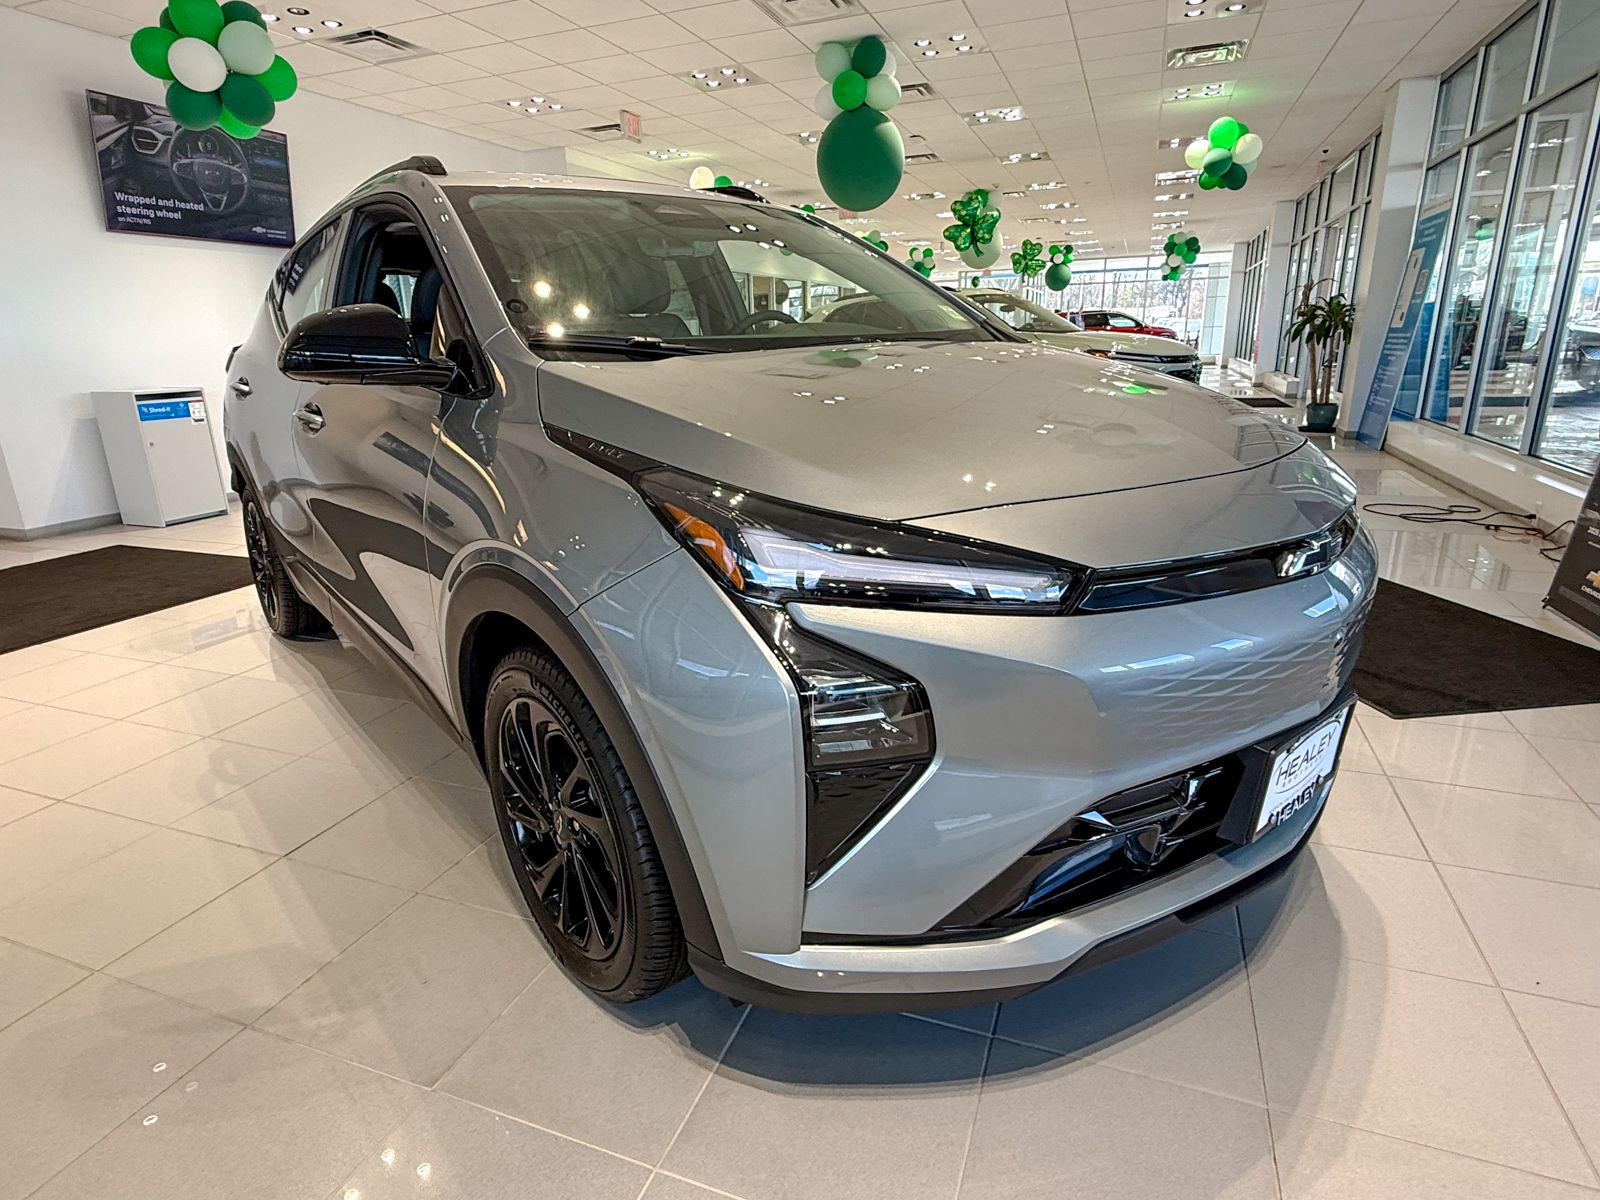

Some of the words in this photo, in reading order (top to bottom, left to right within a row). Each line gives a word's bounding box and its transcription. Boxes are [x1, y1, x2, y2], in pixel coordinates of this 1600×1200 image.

[114, 191, 156, 205] Wrapped
[157, 198, 174, 207] and
[175, 200, 204, 211] heated
[116, 205, 155, 218] steering
[156, 209, 182, 220] wheel
[540, 685, 588, 752] MICHELIN
[1275, 725, 1338, 786] HEALEY
[1276, 781, 1316, 826] HEALEY
